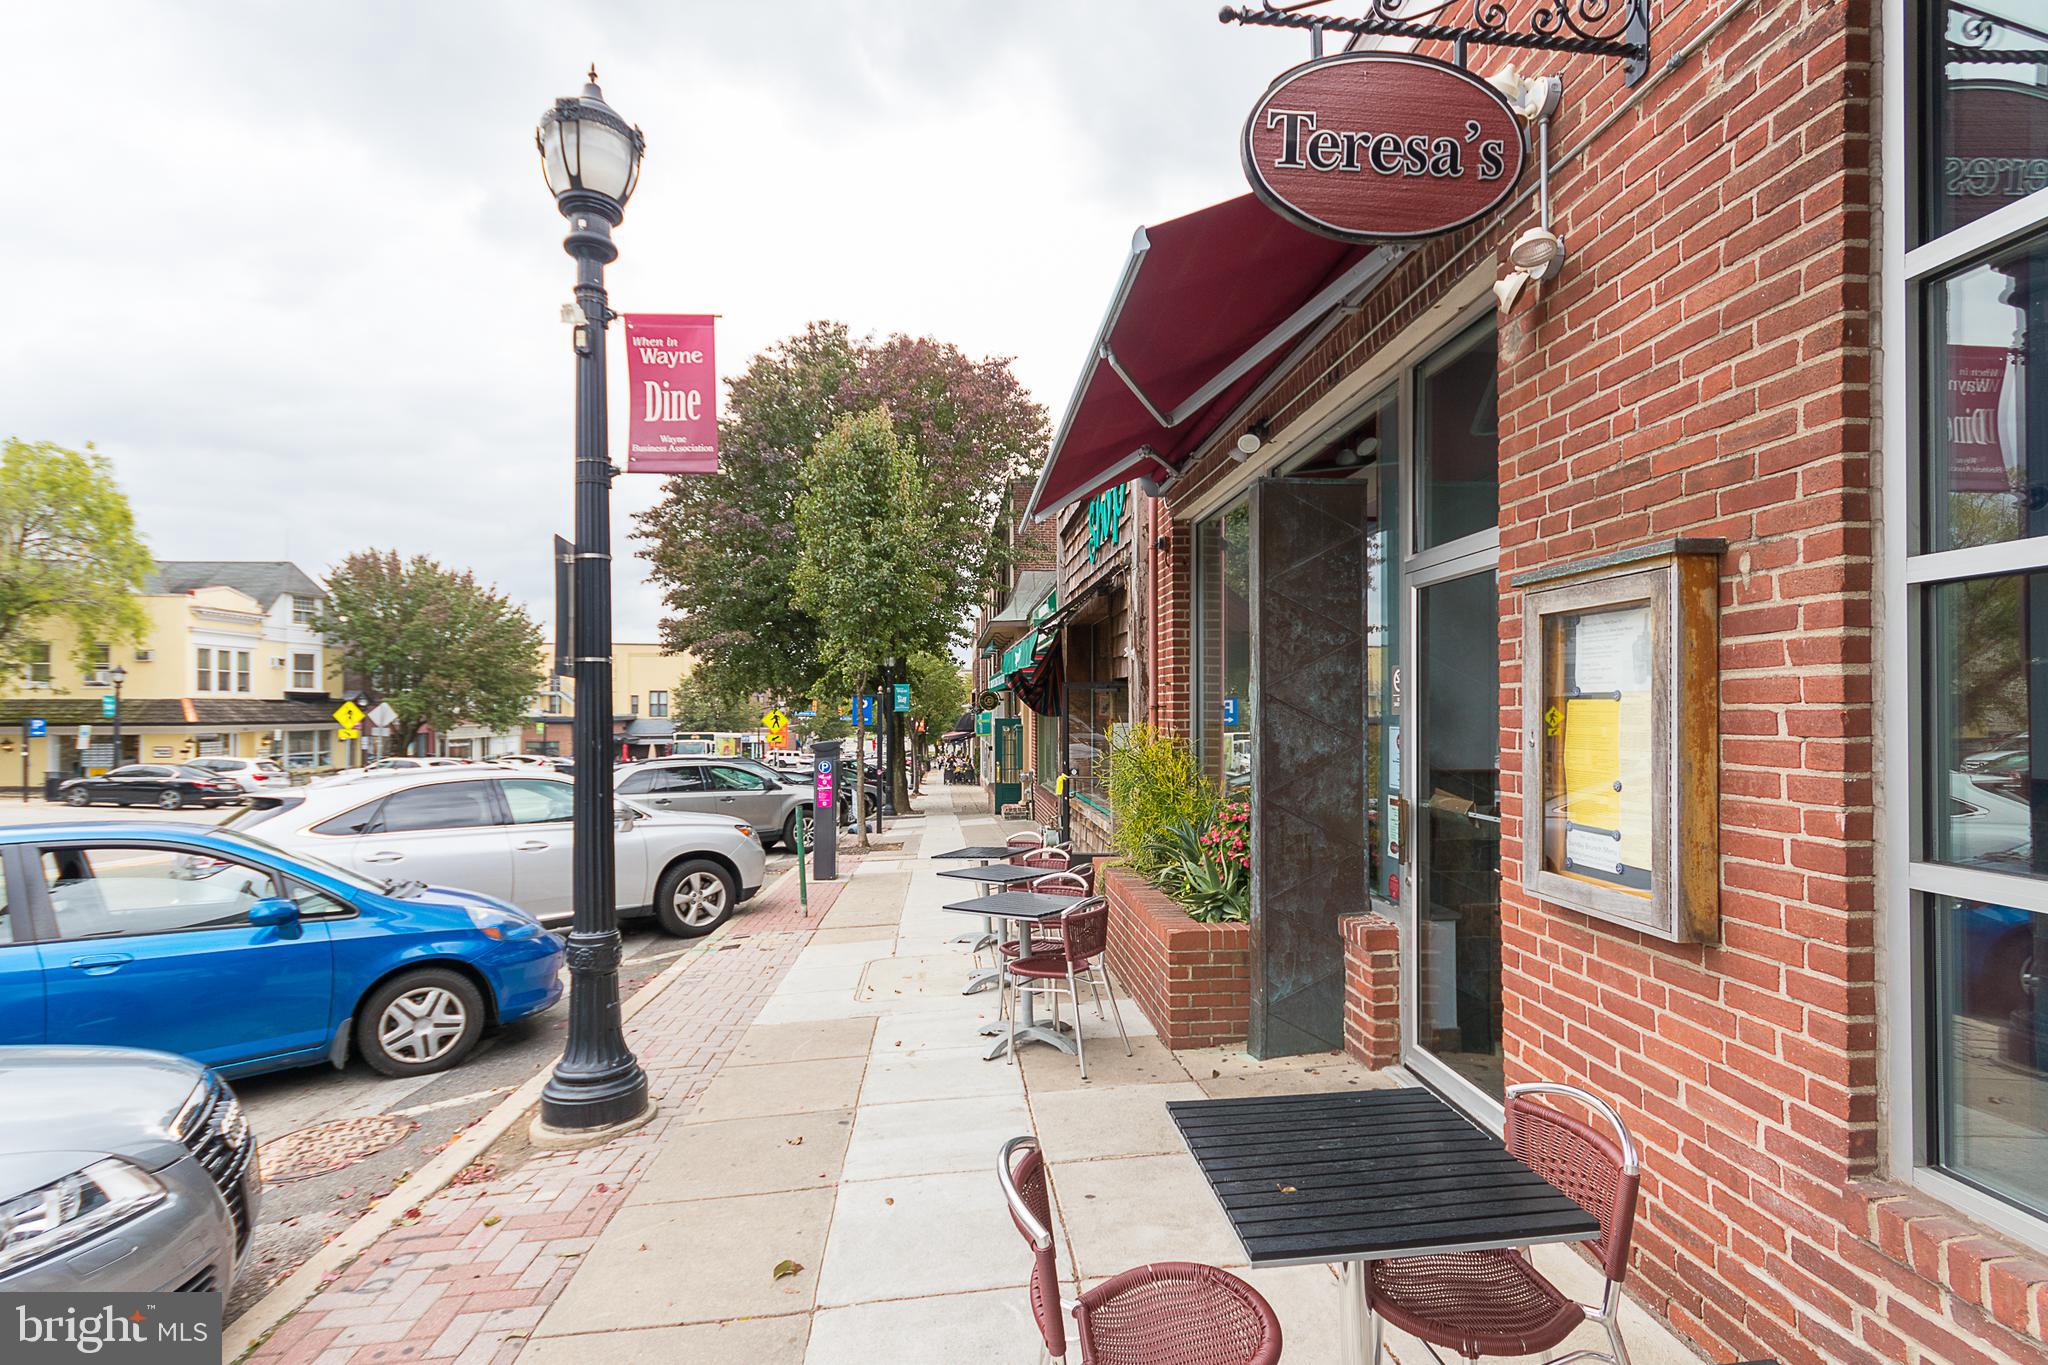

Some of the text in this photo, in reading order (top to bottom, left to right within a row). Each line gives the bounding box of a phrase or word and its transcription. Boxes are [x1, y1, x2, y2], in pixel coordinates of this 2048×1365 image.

[1267, 108, 1504, 180] Teresa's
[632, 336, 679, 347] When in
[639, 347, 704, 369] Wayne
[643, 380, 701, 422] Dine
[659, 434, 687, 445] Wayne
[632, 443, 714, 453] Business Association
[821, 762, 829, 773] P
